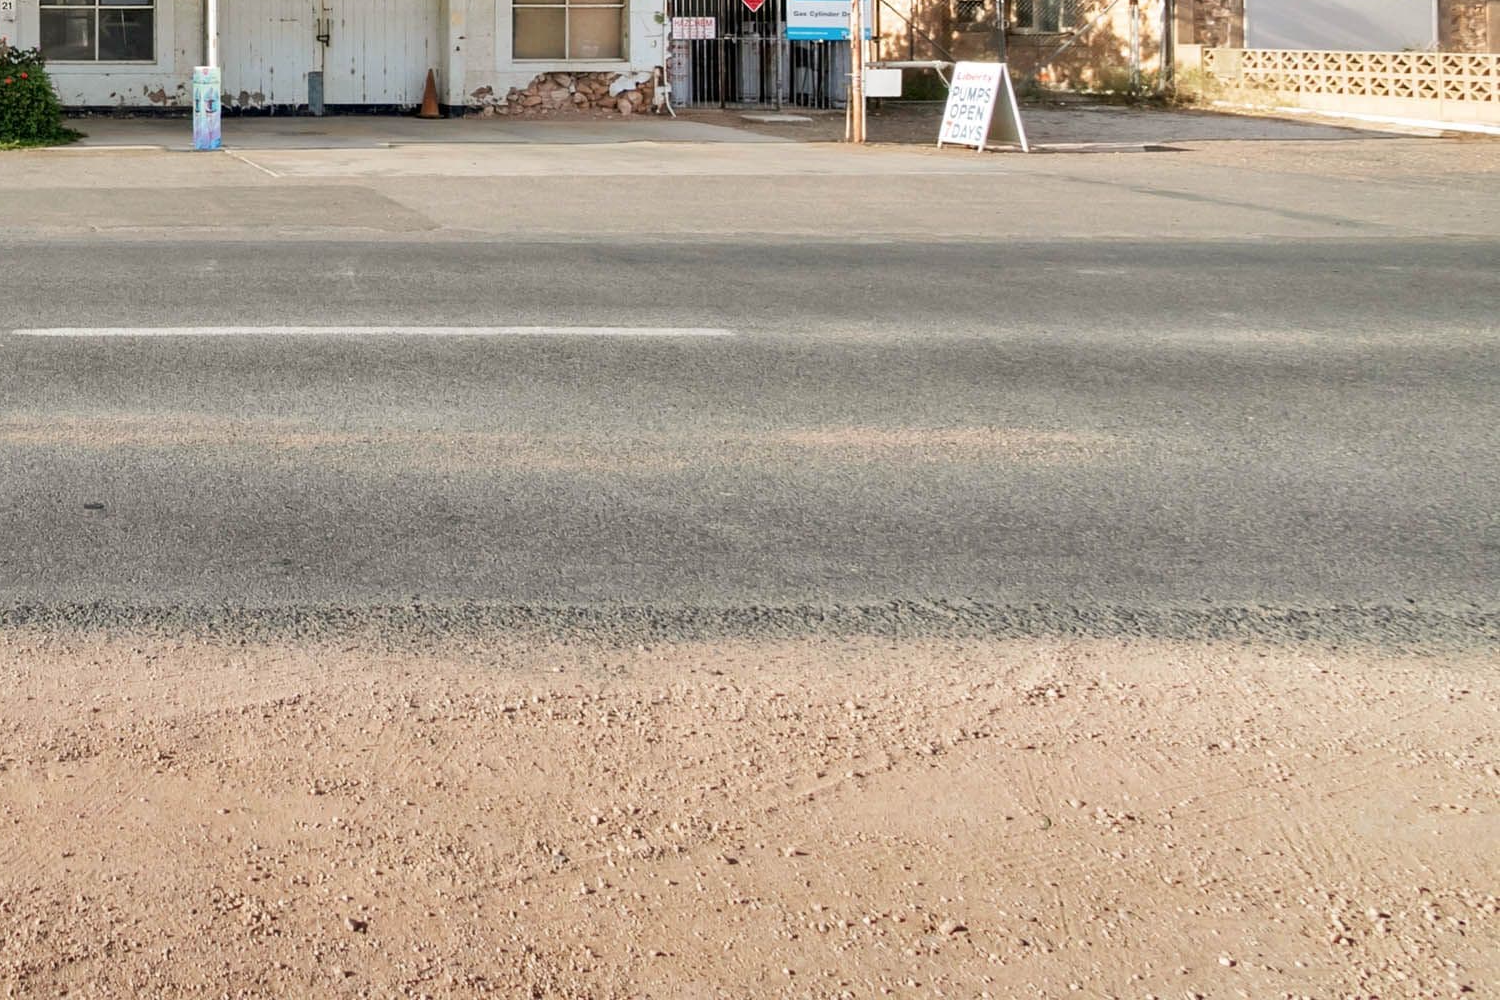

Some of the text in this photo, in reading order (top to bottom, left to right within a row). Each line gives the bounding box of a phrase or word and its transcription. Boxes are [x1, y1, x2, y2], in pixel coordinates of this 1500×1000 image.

[2, 1, 12, 10] 21
[809, 10, 840, 18] Cylinder
[674, 19, 714, 28] HAZCHEM
[952, 86, 991, 103] PUMPS
[949, 104, 985, 121] OPEN
[944, 120, 984, 141] 7 DAYS
